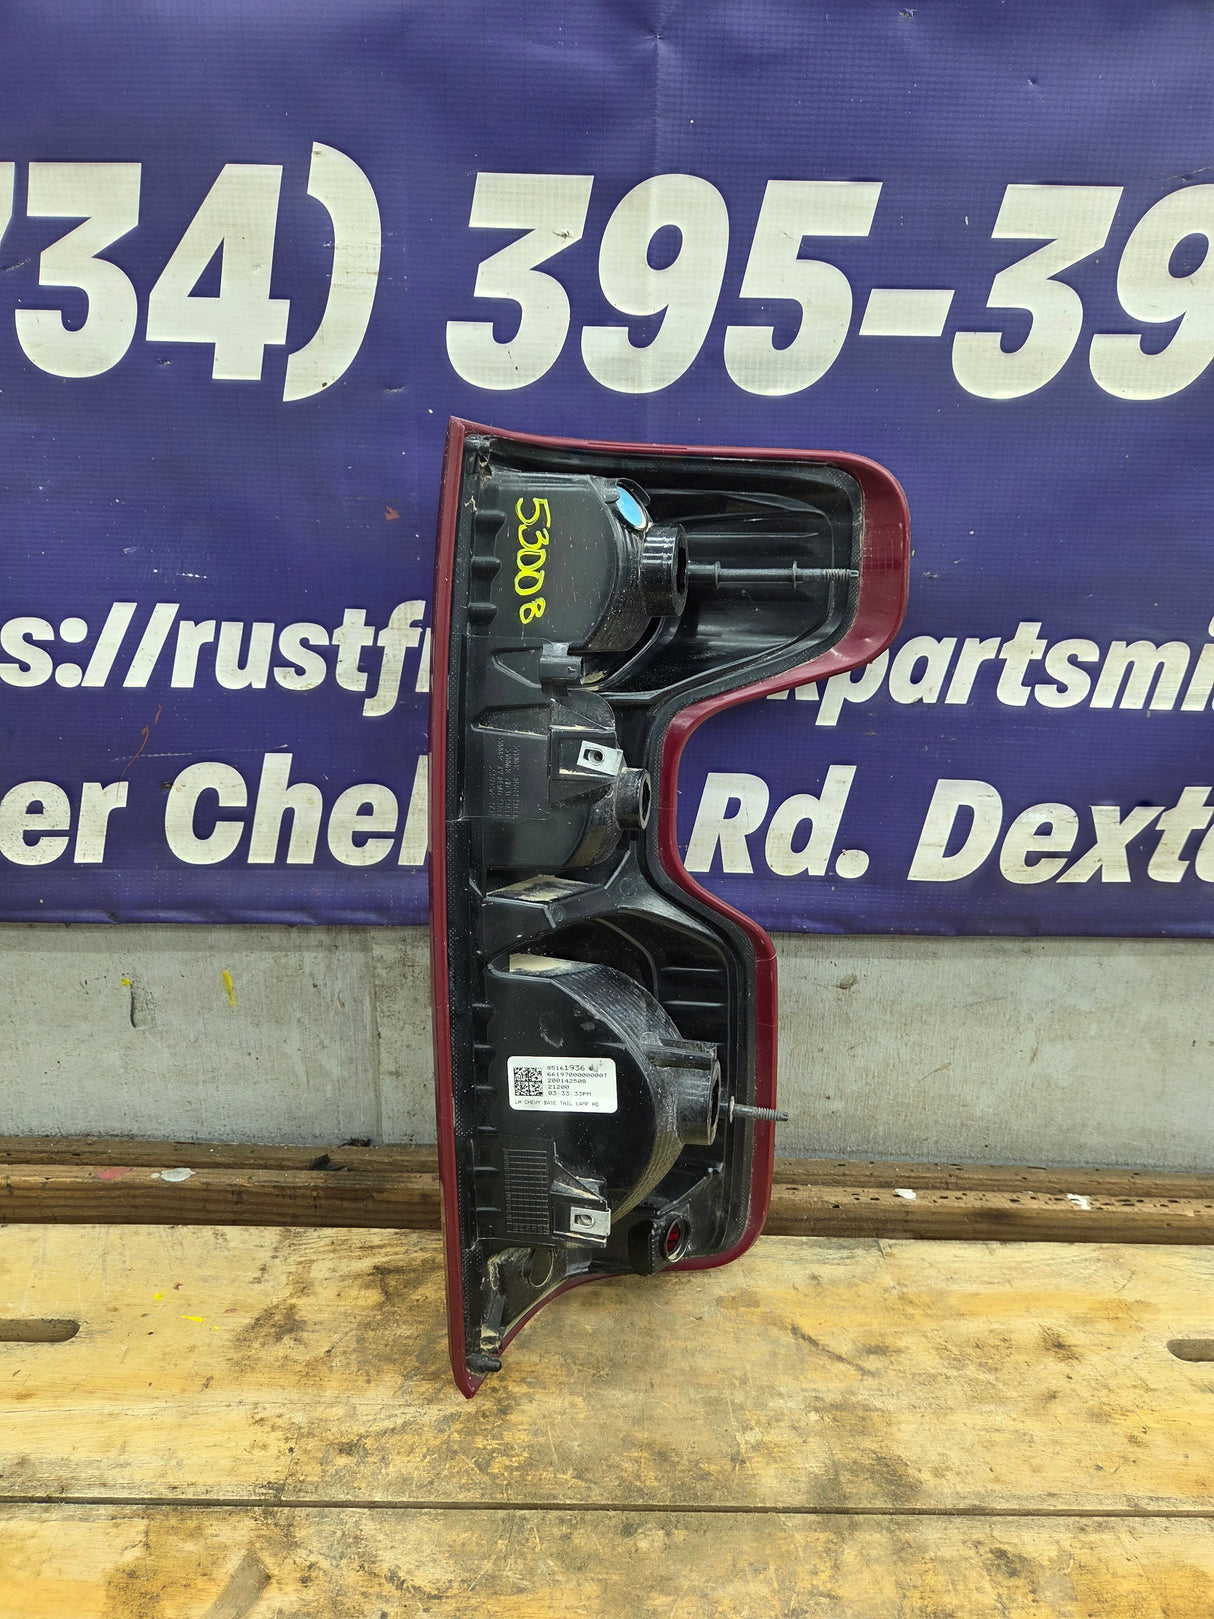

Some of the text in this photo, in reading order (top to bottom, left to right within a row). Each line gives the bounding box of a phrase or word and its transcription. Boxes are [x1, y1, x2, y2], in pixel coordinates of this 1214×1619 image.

[0, 141, 1214, 402] 34) 395-39
[0, 600, 1214, 726] s://rustf partsmi
[683, 764, 870, 879] Rd.
